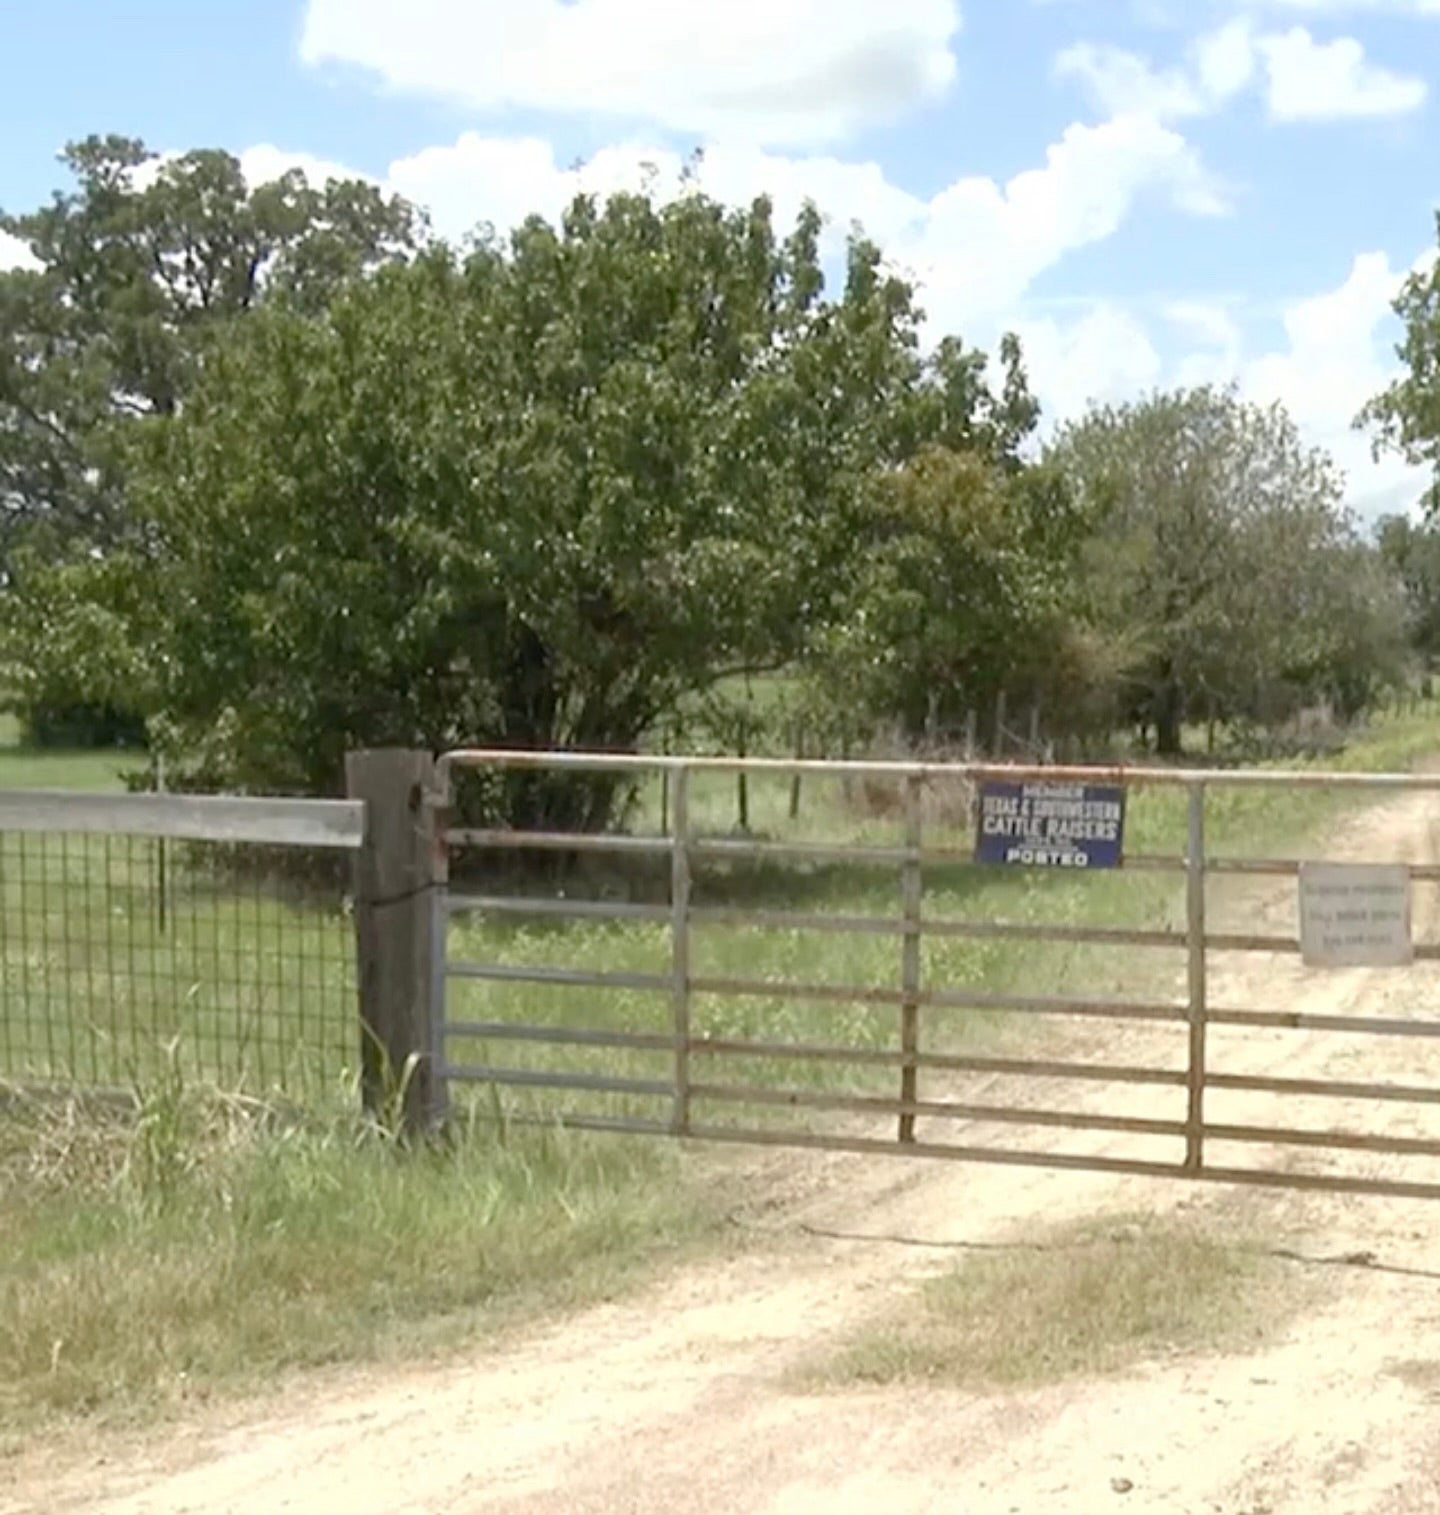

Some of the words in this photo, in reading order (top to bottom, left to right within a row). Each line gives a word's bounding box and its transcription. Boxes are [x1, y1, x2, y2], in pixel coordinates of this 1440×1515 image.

[983, 816, 1042, 837] CATTLE
[1046, 818, 1118, 840] RAISERS
[1006, 848, 1088, 867] POSTED
